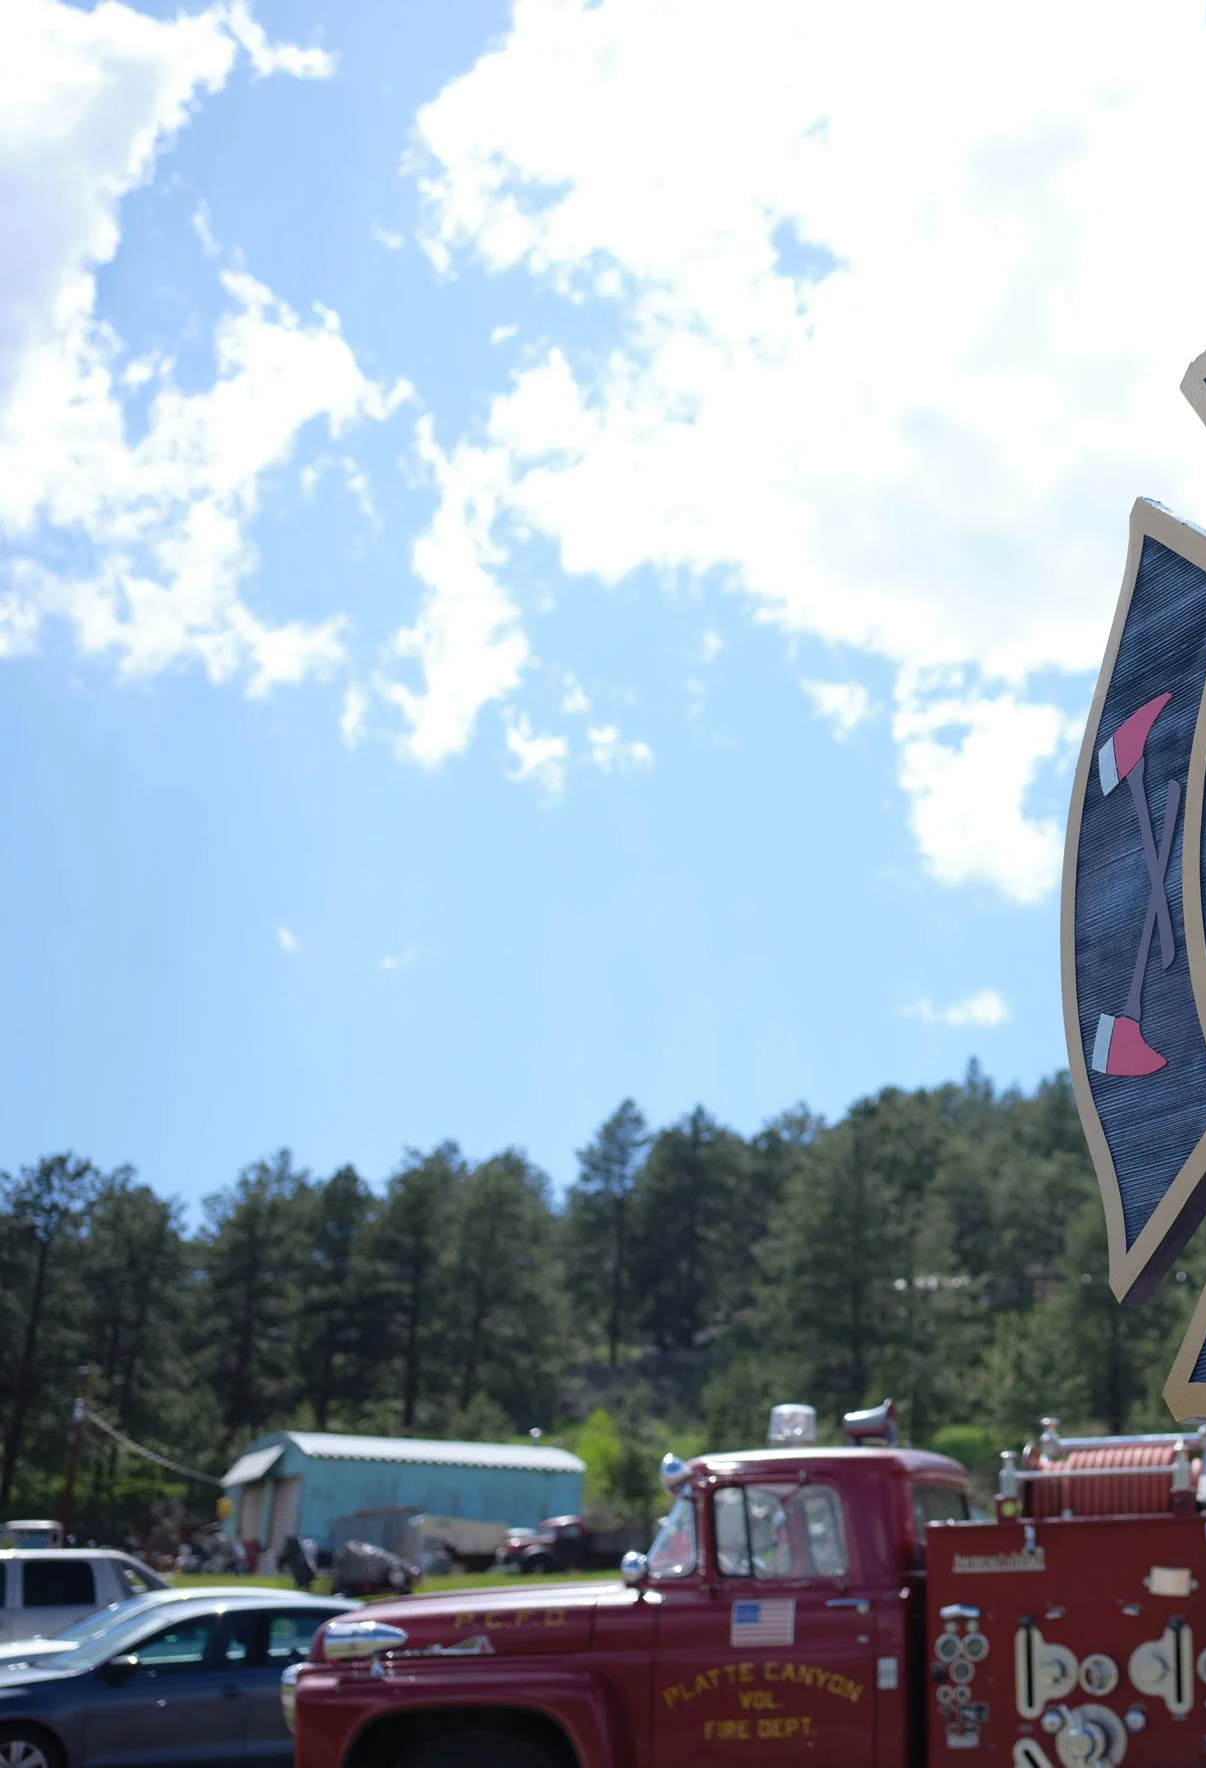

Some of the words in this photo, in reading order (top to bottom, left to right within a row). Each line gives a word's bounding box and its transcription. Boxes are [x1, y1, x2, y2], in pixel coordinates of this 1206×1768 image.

[661, 1662, 754, 1709] PLATTE
[763, 1661, 864, 1702] CANYON
[703, 1719, 750, 1741] FIRE
